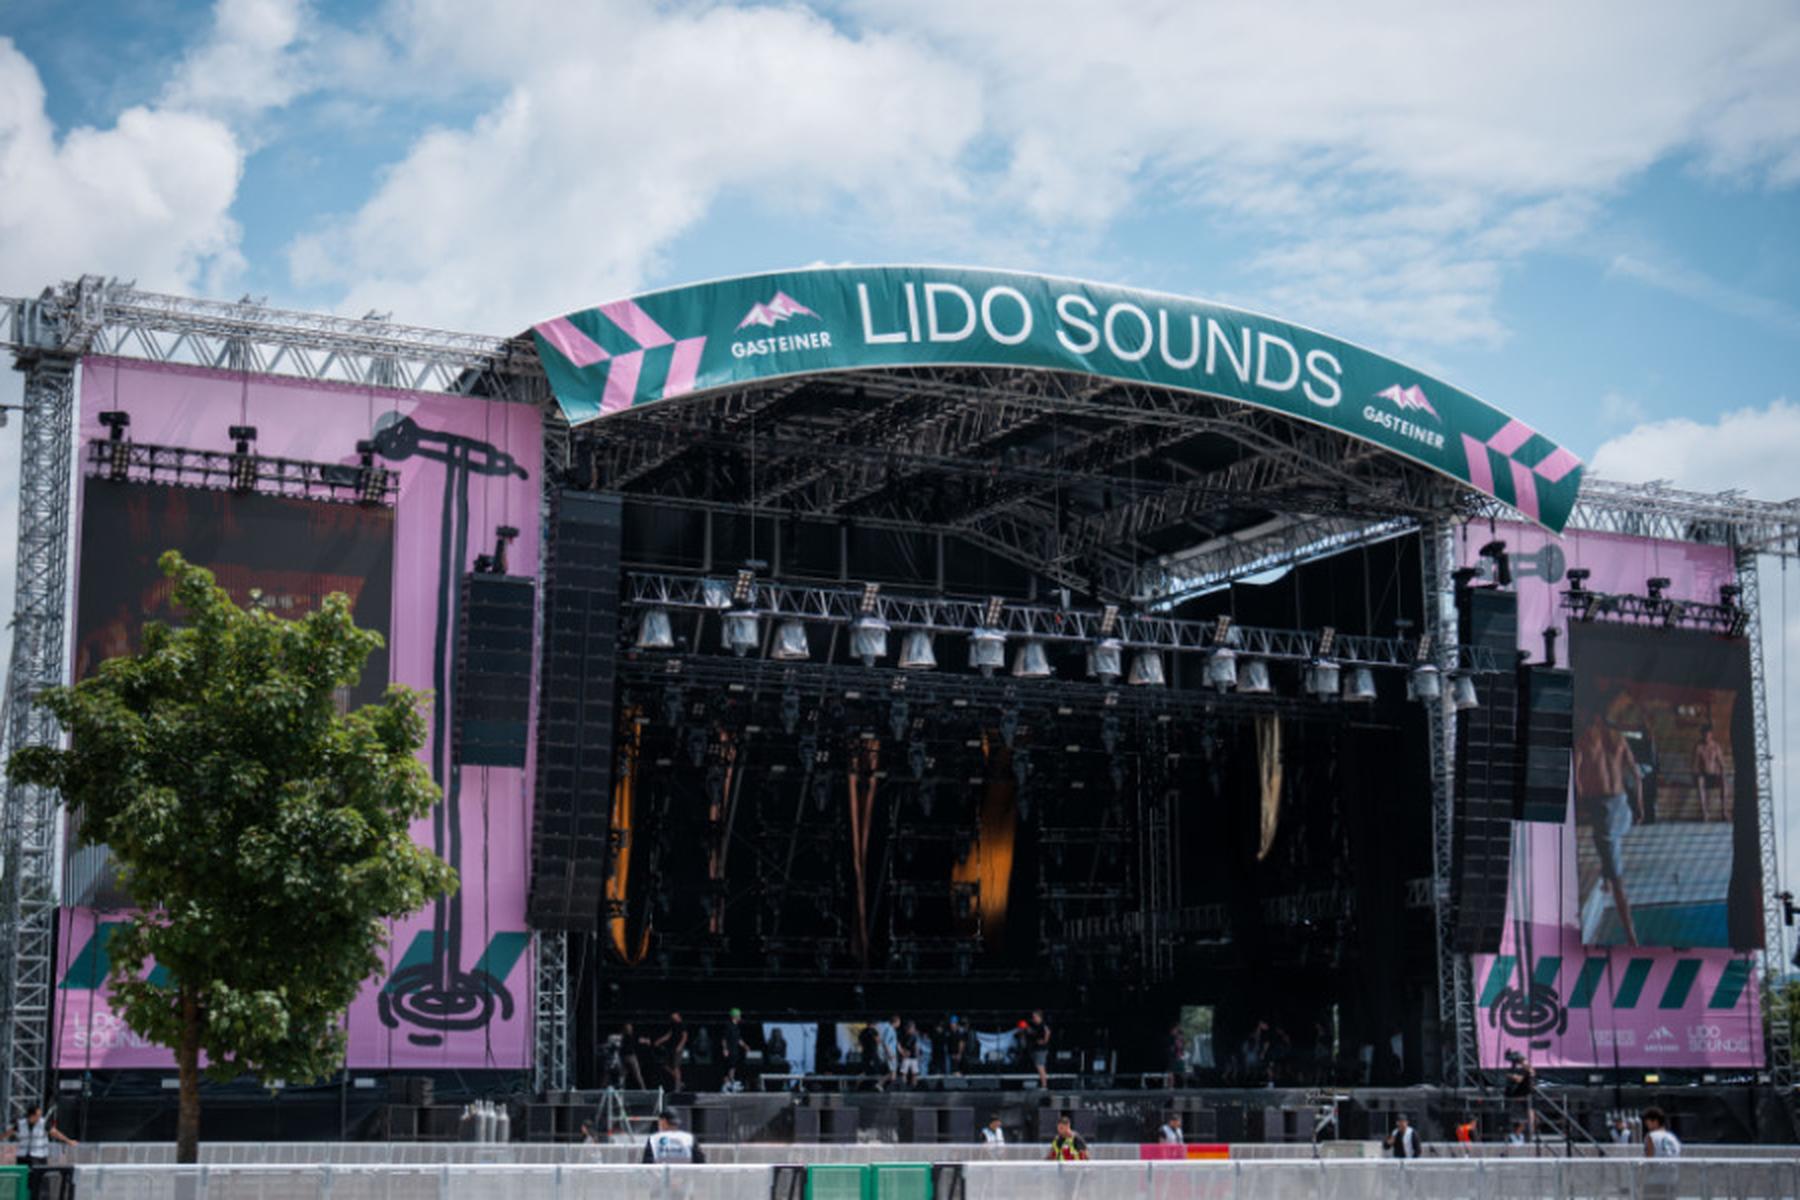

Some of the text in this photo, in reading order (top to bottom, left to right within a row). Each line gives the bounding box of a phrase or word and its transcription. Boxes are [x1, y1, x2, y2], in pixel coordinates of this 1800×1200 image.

[731, 331, 832, 358] GASTEINER
[858, 282, 1343, 407] LIDO SOUNDS
[1363, 405, 1445, 450] GASTEINER
[75, 1012, 124, 1031] LDO
